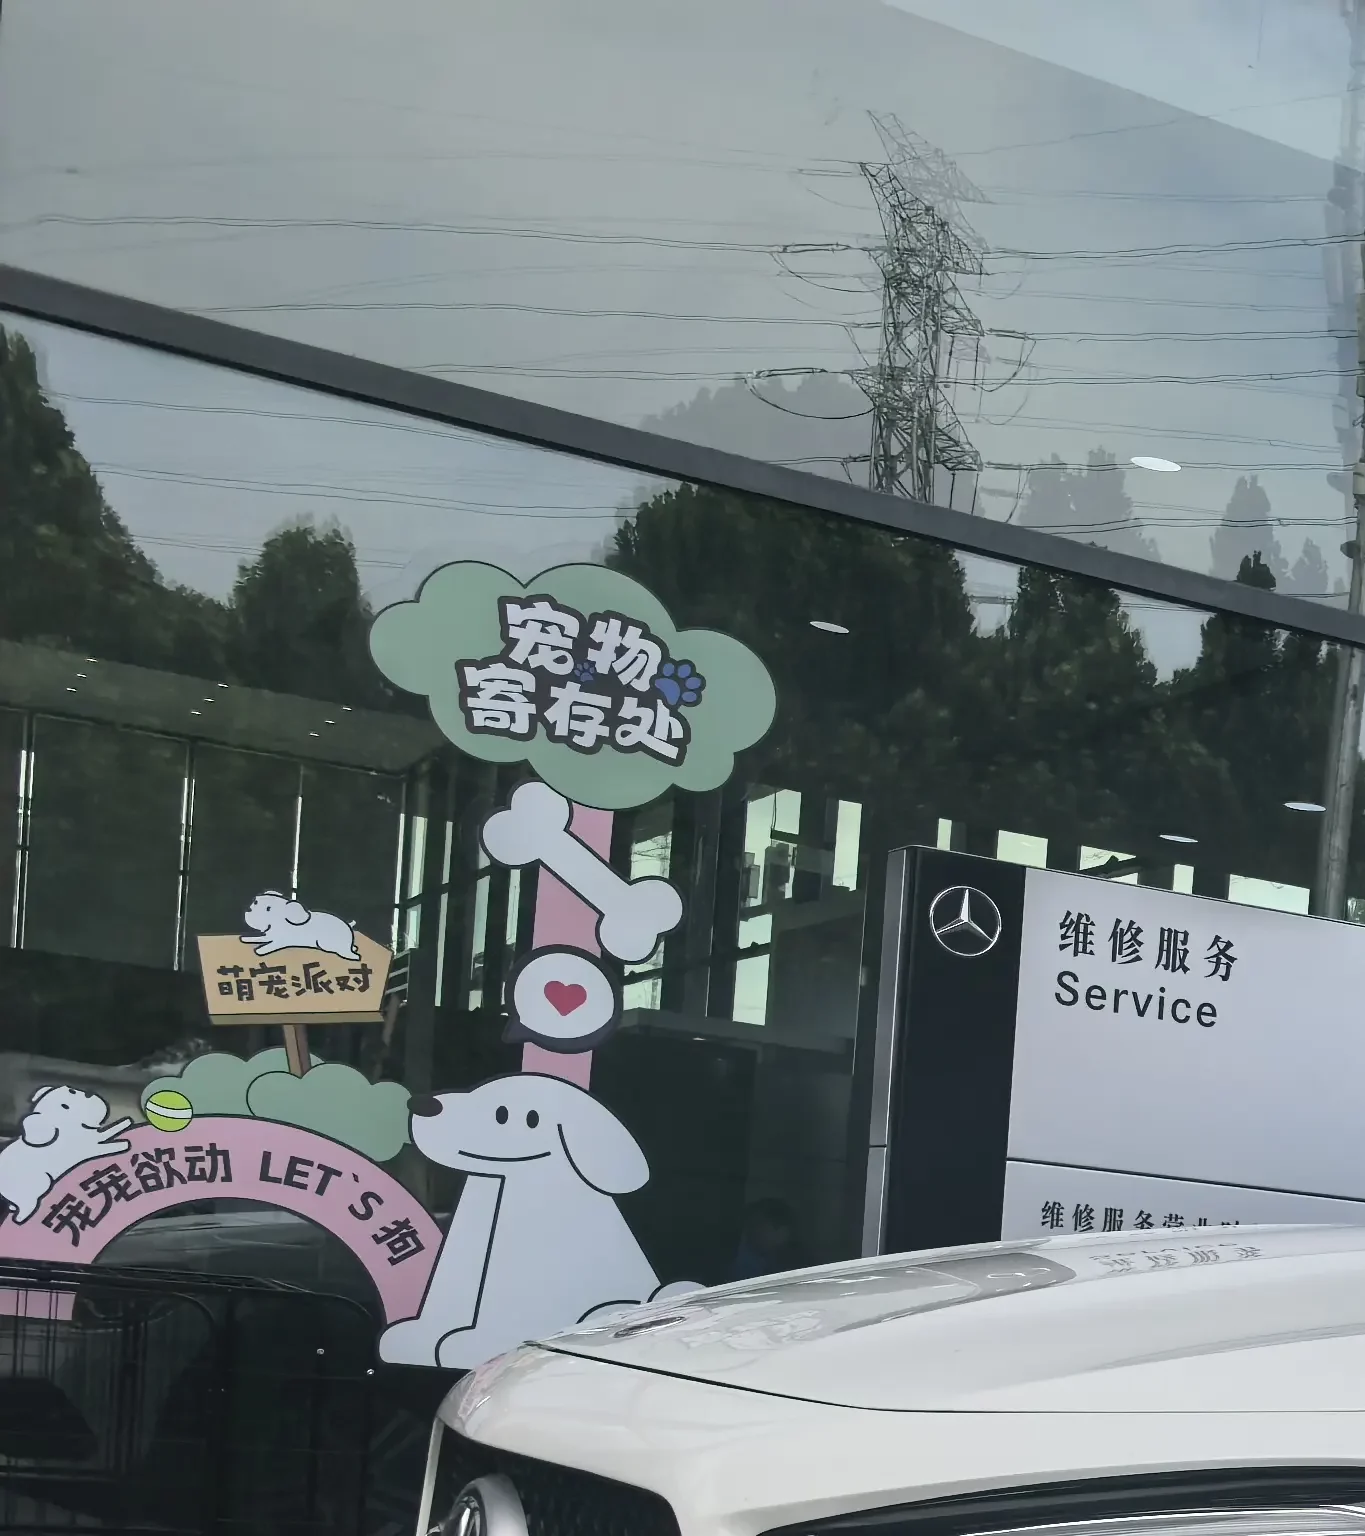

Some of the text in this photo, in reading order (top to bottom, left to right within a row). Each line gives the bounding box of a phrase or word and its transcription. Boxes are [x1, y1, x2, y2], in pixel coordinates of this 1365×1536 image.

[505, 601, 662, 692] 宠物
[463, 662, 684, 760] 寄存处
[216, 961, 373, 1002] 萌宠派对
[1058, 909, 1238, 982] 维修服务
[1054, 971, 1218, 1028] Service
[41, 1142, 233, 1247] 宠宠欲动
[371, 1217, 426, 1266] 狗
[1041, 1200, 1240, 1233] 维修服务营
